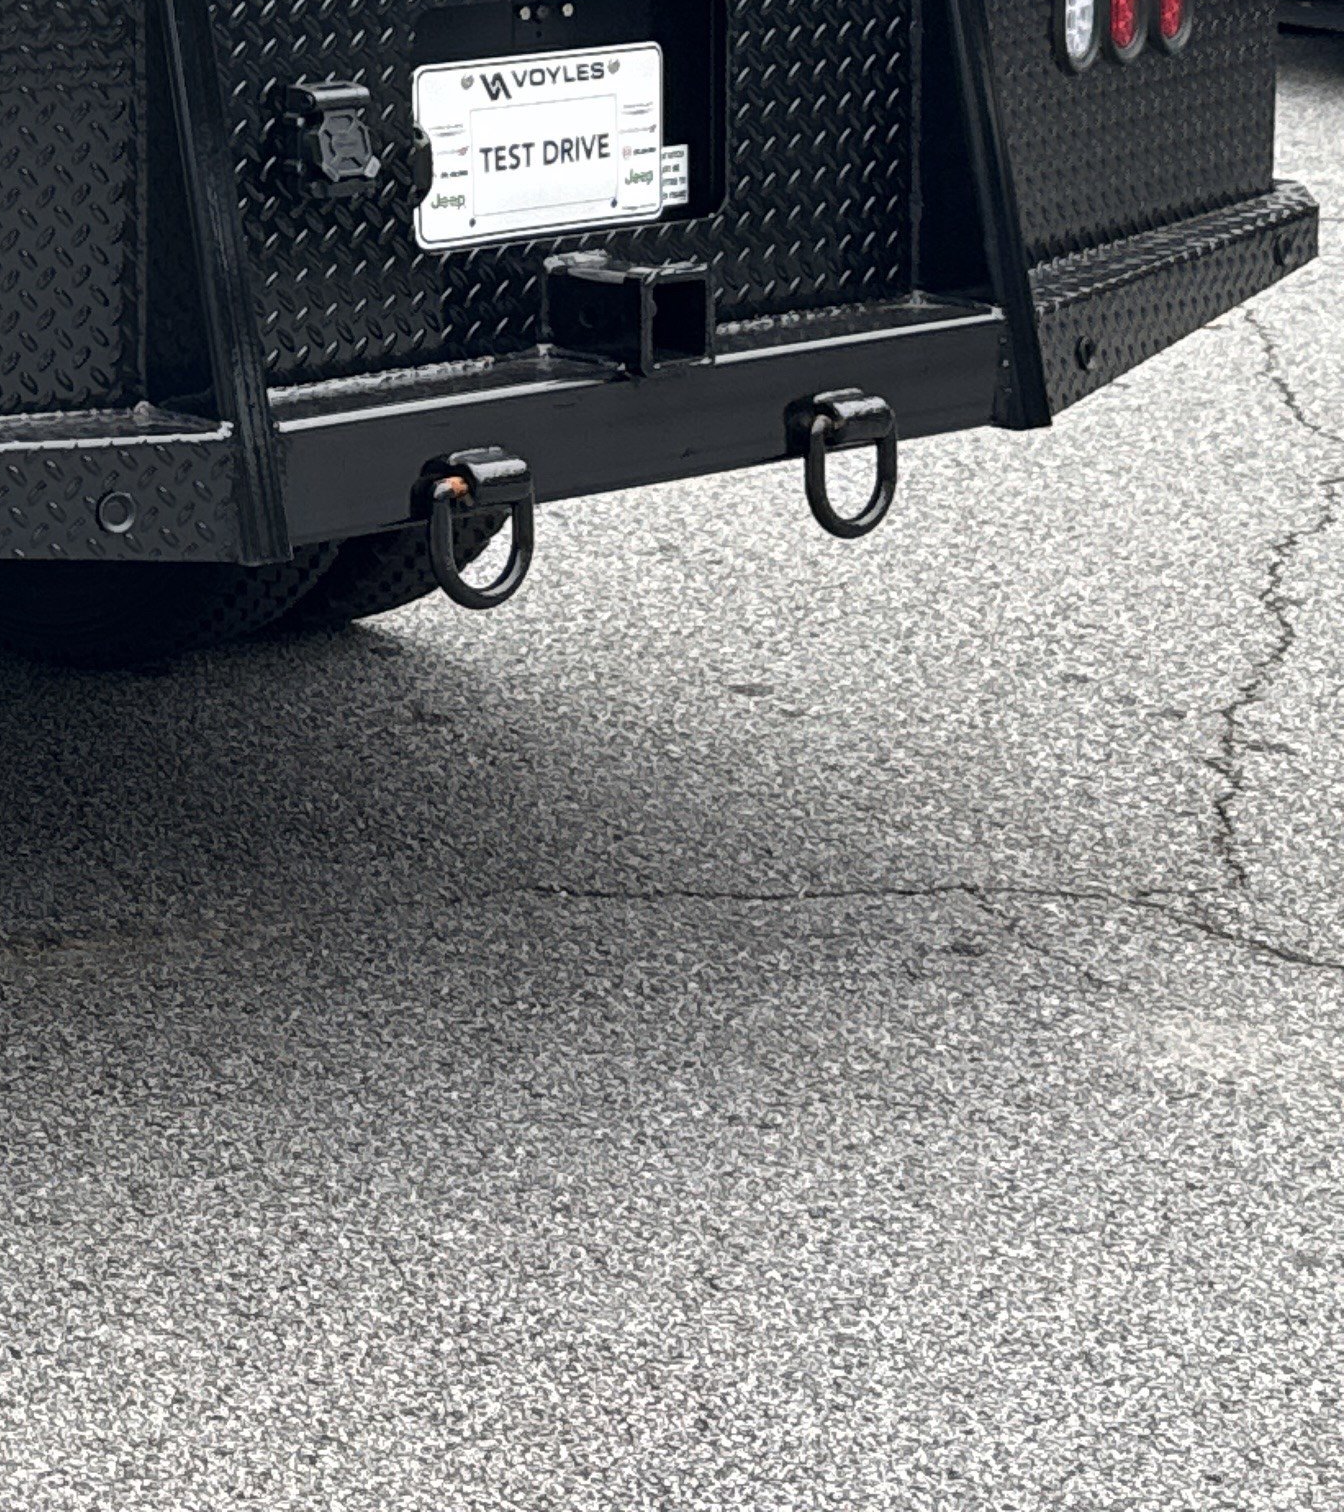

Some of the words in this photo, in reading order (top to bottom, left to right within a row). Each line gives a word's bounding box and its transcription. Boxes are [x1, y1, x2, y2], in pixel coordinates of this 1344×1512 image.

[511, 61, 605, 87] VOYLES
[479, 141, 536, 174] TEST
[542, 133, 611, 167] DRIVE
